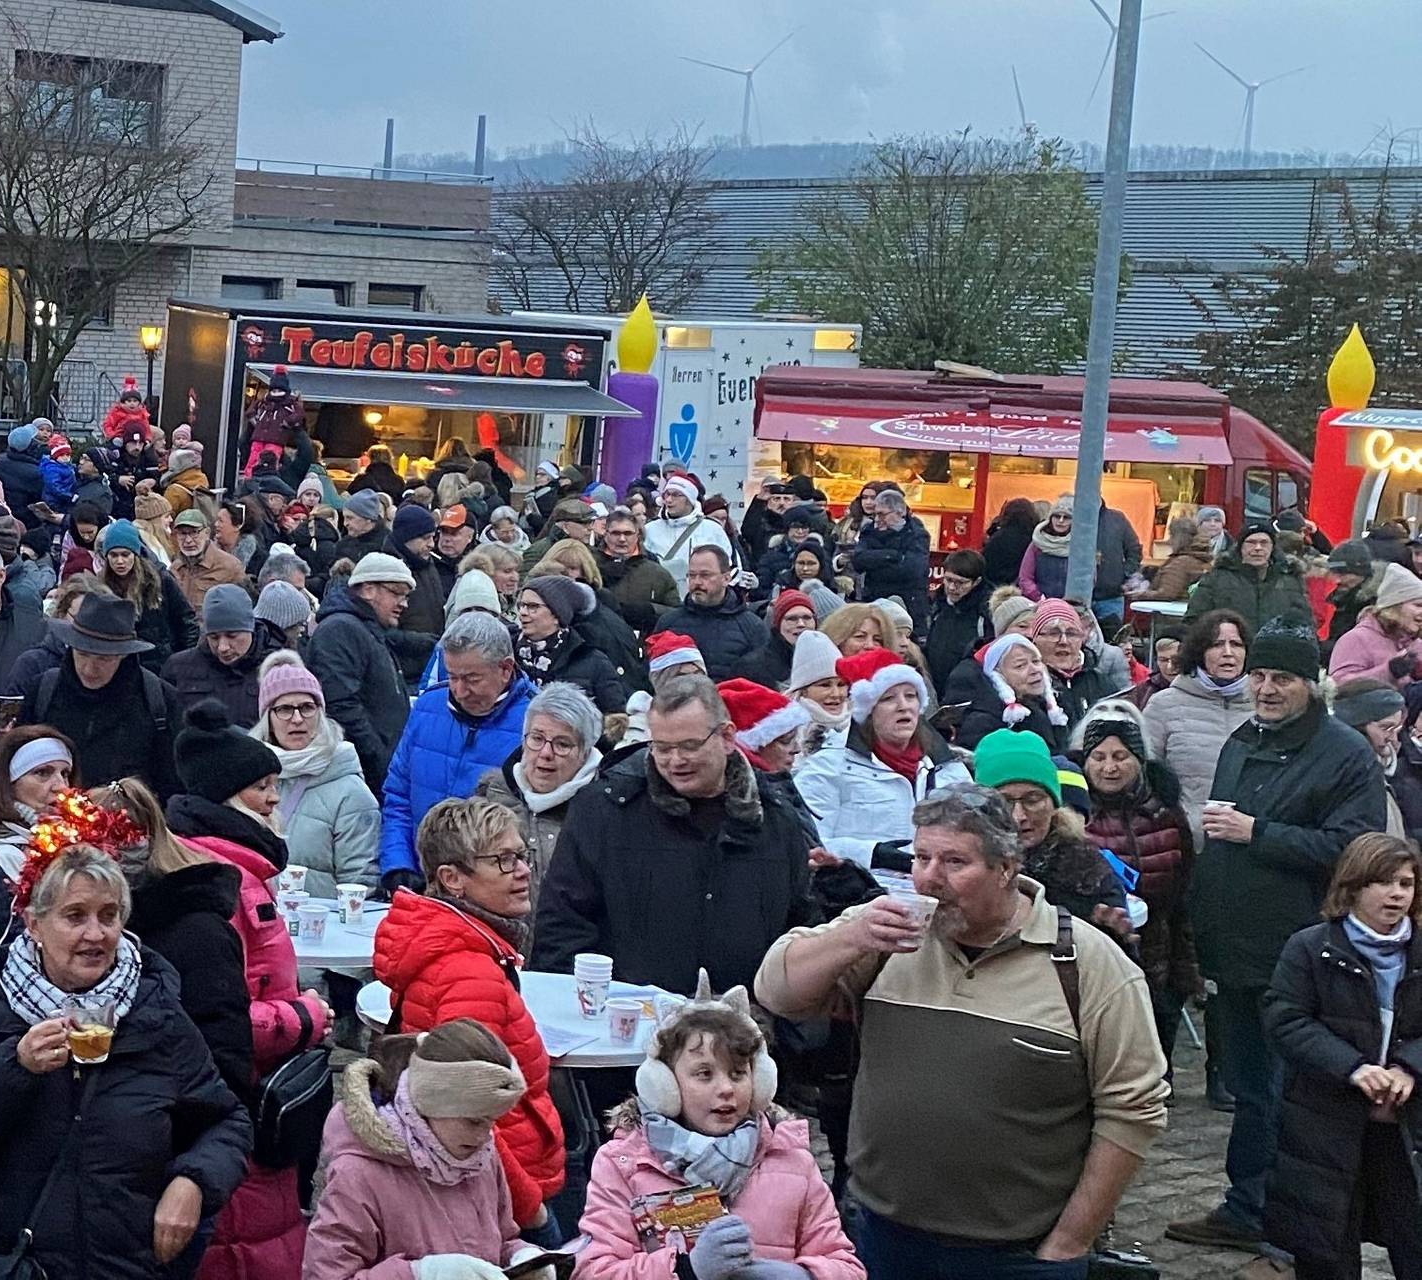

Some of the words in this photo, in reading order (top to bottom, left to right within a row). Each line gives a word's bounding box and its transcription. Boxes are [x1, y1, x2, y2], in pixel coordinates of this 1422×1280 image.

[281, 326, 546, 378] Teufelsküche
[671, 366, 703, 383] Herren
[718, 365, 764, 405] Even
